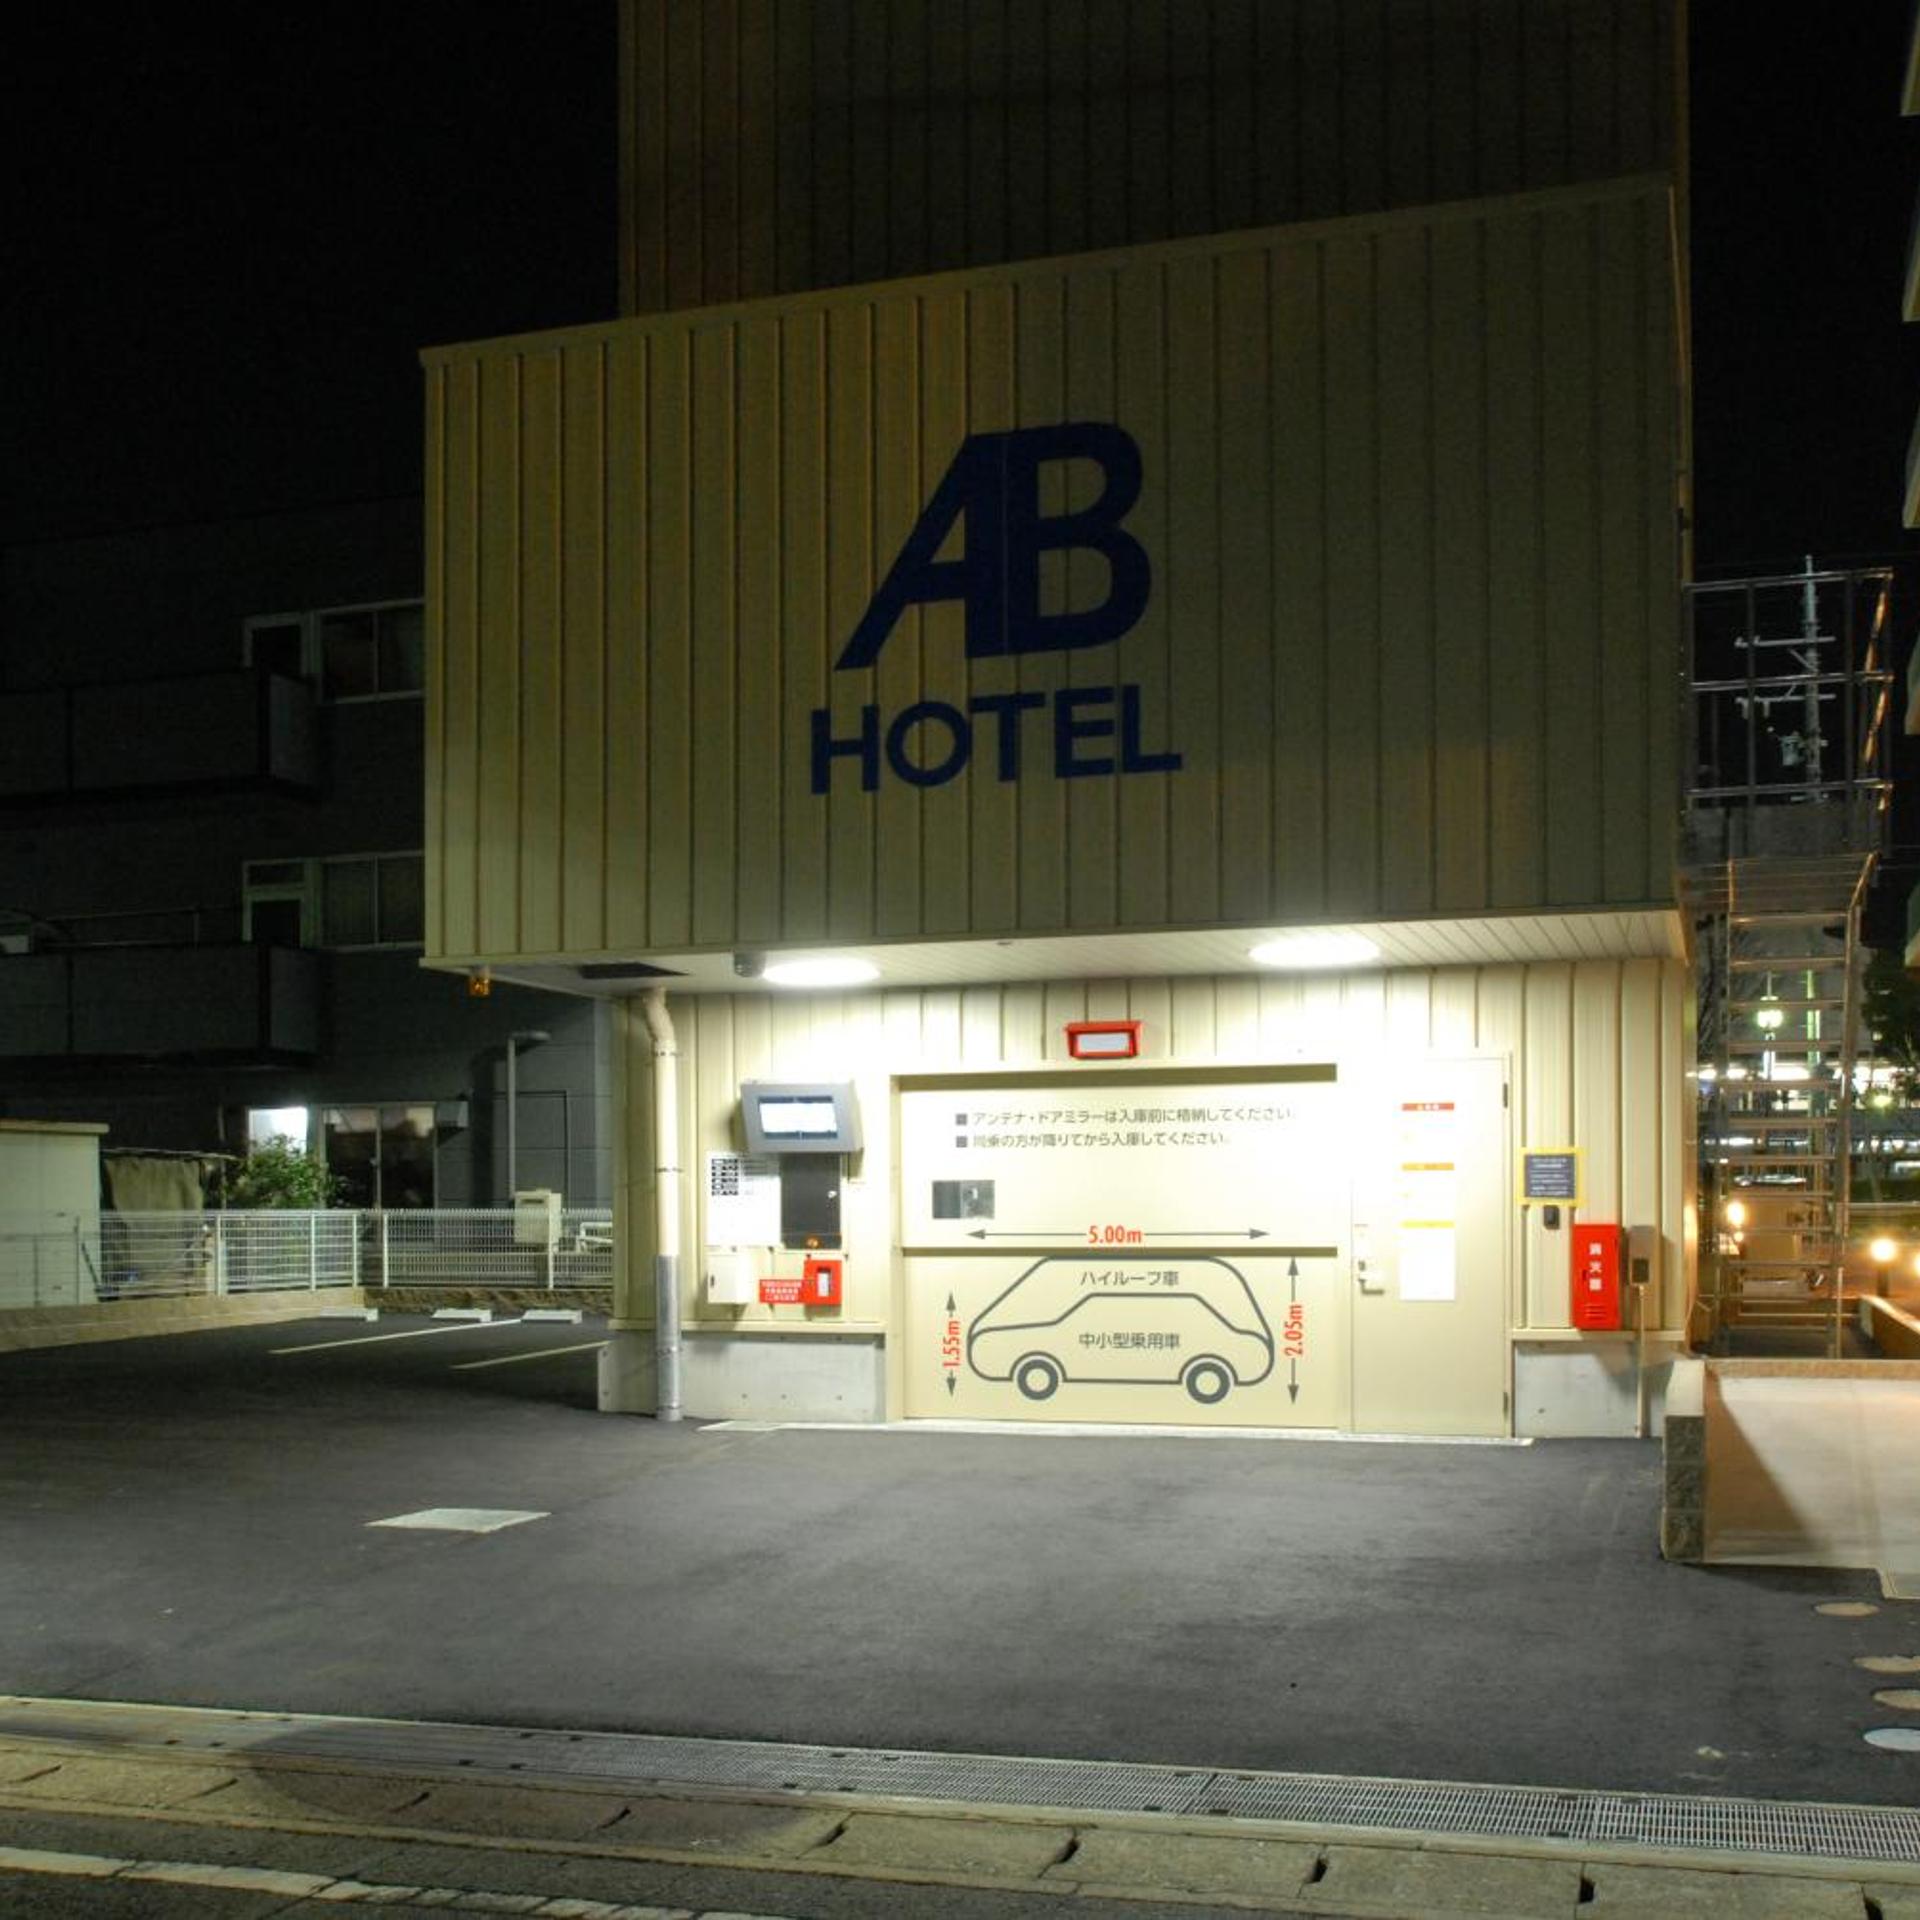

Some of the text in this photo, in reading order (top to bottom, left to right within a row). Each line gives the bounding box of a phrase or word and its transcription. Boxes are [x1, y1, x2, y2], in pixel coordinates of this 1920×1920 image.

[834, 422, 1151, 671] AB
[811, 684, 1182, 794] HOTEL
[1088, 1225, 1142, 1243] 5.00m
[1080, 1270, 1180, 1287] ハイルーフ車
[943, 1320, 961, 1368] 1.55m
[1078, 1333, 1181, 1349] 中小型乗用車
[1284, 1304, 1303, 1357] 2.05m
